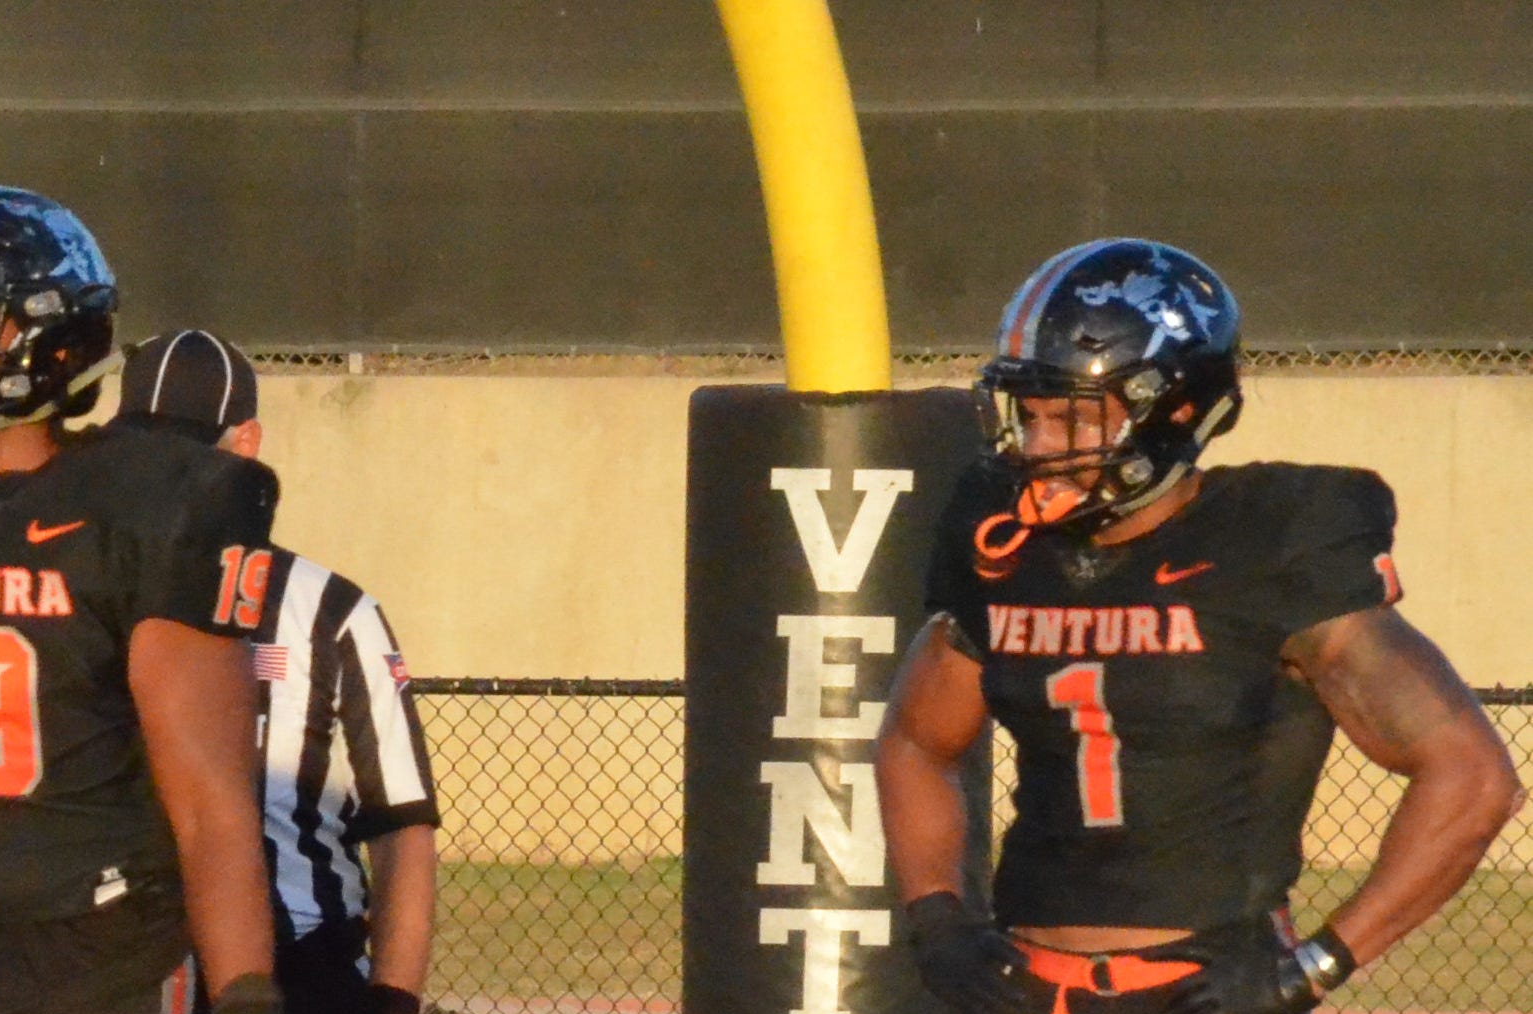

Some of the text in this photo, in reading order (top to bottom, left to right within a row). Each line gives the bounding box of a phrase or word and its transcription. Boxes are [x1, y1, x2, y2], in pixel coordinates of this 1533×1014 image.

[213, 544, 273, 630] 19
[987, 604, 1206, 655] VENTURA
[1045, 661, 1125, 828] 1
